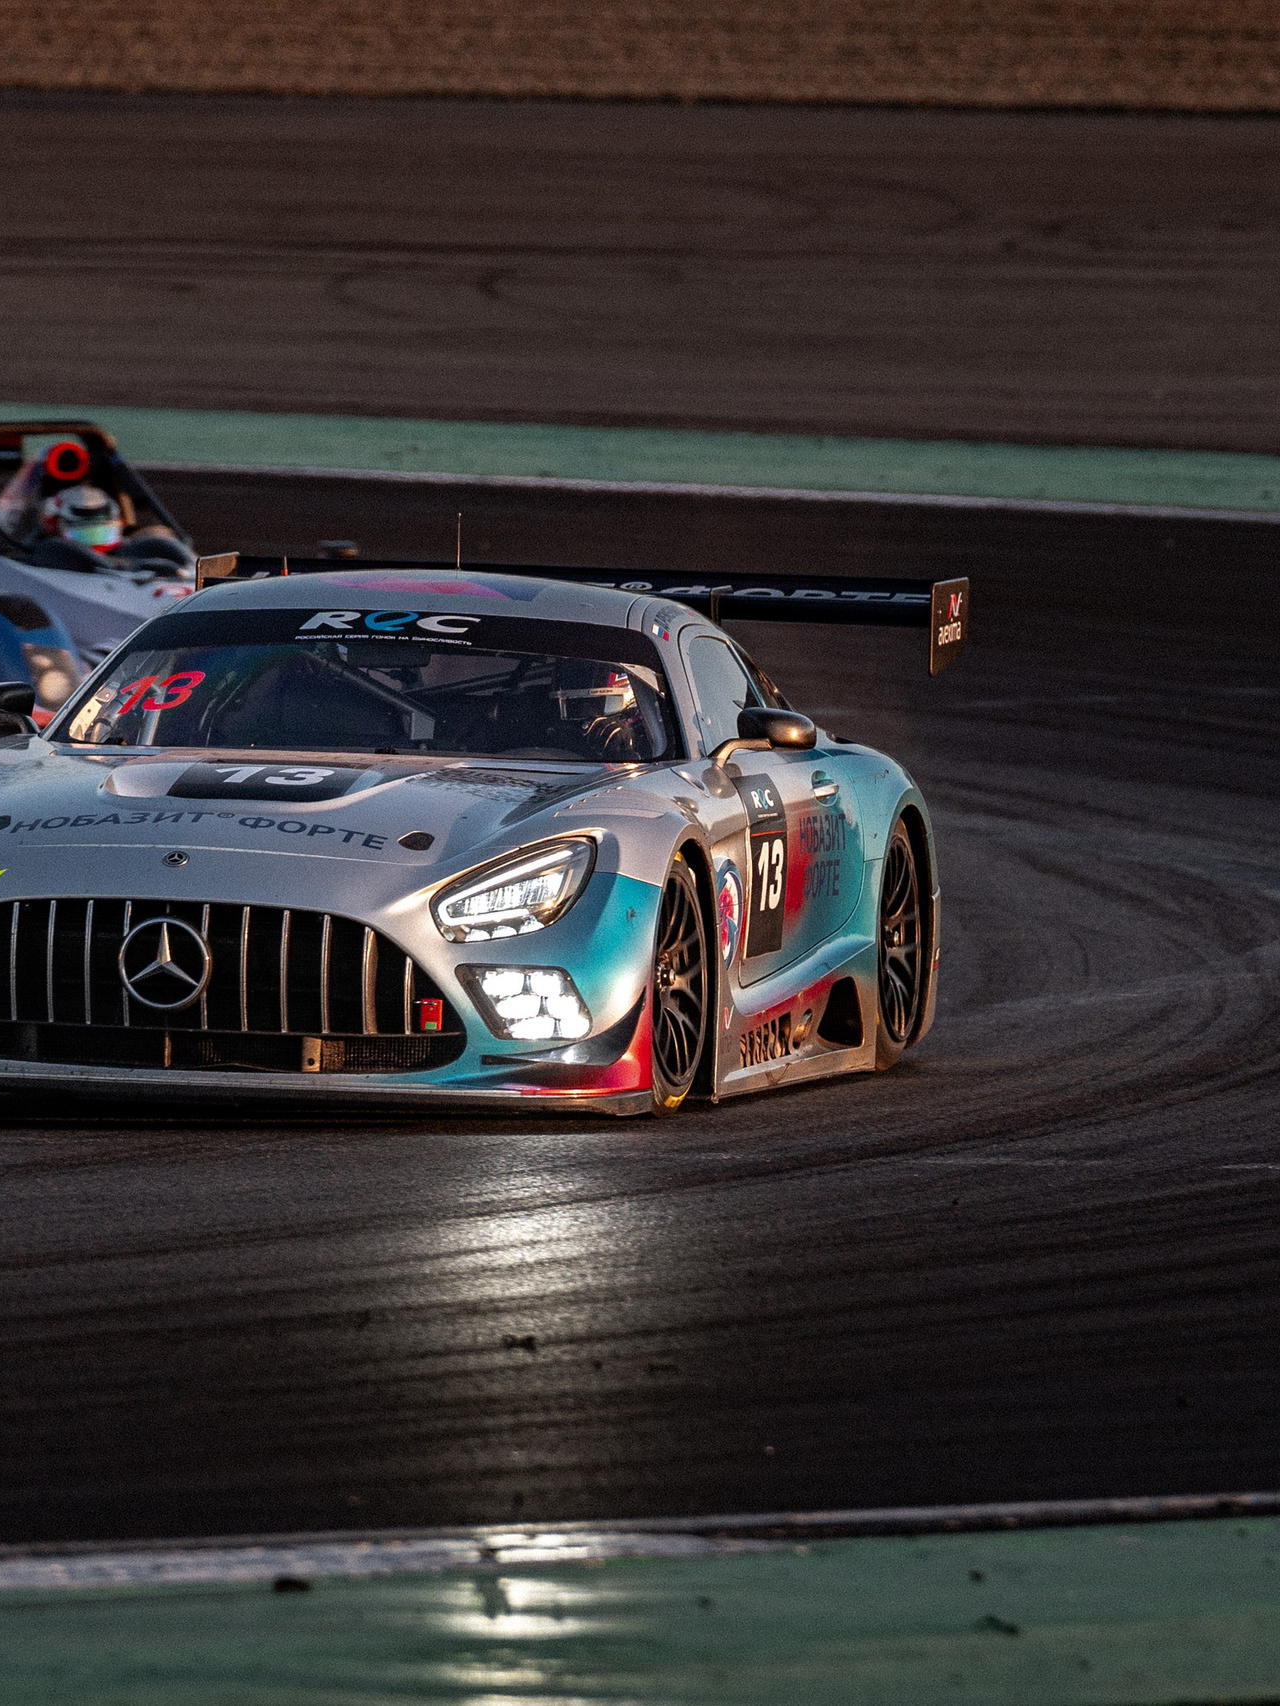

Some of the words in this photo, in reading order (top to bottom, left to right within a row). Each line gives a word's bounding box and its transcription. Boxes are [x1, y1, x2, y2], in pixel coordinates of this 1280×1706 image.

[117, 670, 206, 714] 13
[216, 766, 335, 786] 13
[238, 816, 389, 851] ФОРТЕ
[757, 838, 785, 912] 13
